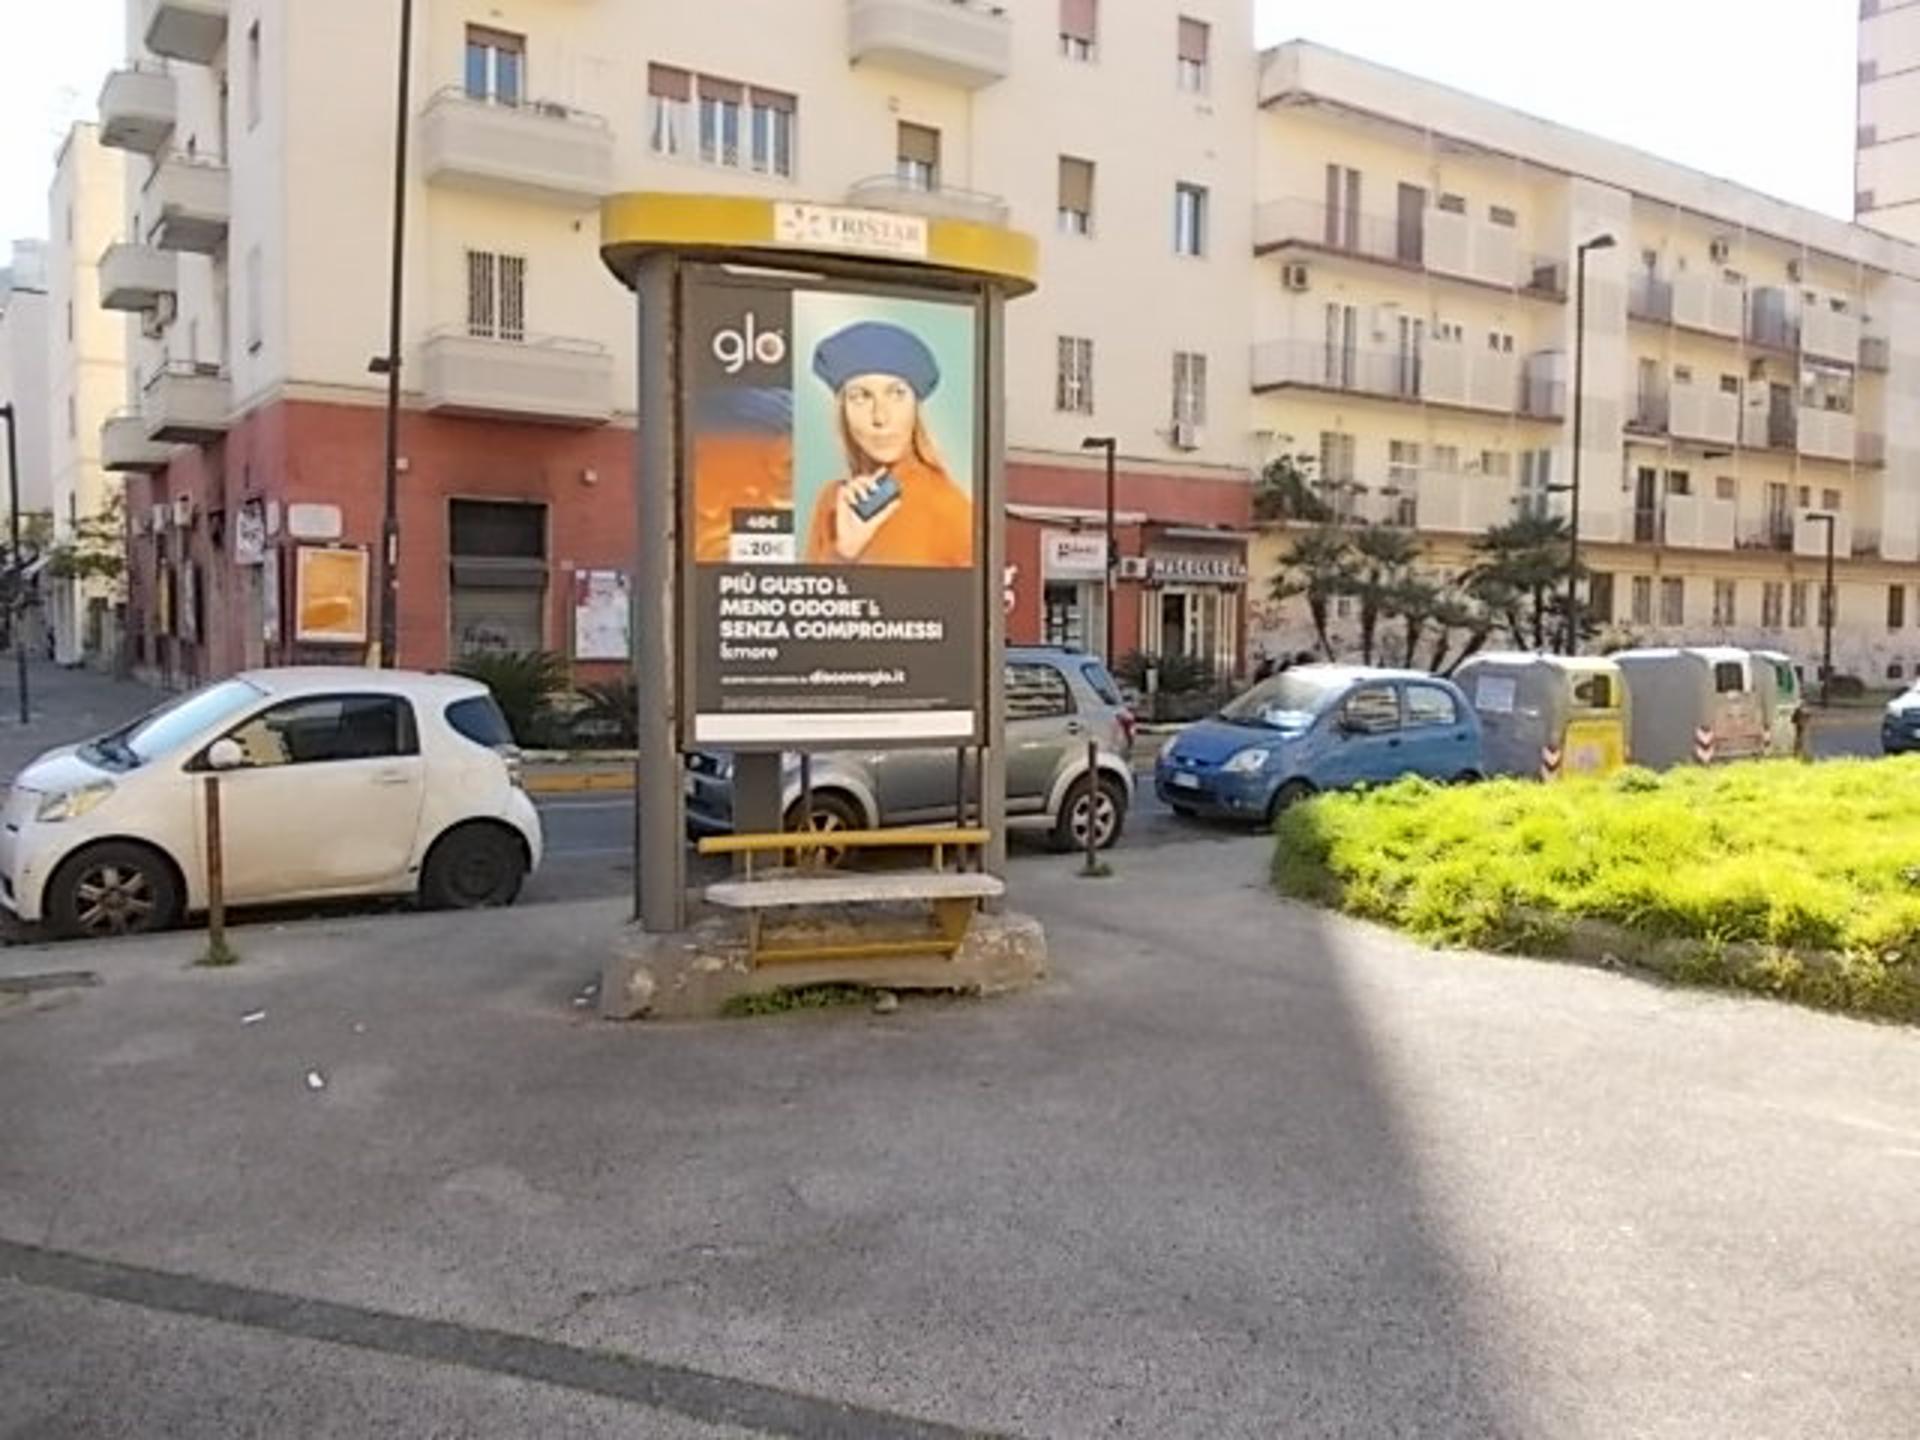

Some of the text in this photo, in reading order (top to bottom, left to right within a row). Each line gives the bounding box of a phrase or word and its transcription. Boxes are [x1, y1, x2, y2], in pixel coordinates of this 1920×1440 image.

[830, 214, 919, 241] TRISTAR
[713, 311, 785, 373] glo
[719, 572, 756, 595] PIÙ
[759, 577, 834, 595] GUSTO
[719, 599, 786, 616] MENO
[719, 620, 944, 640] SENZA COMPROMESSI
